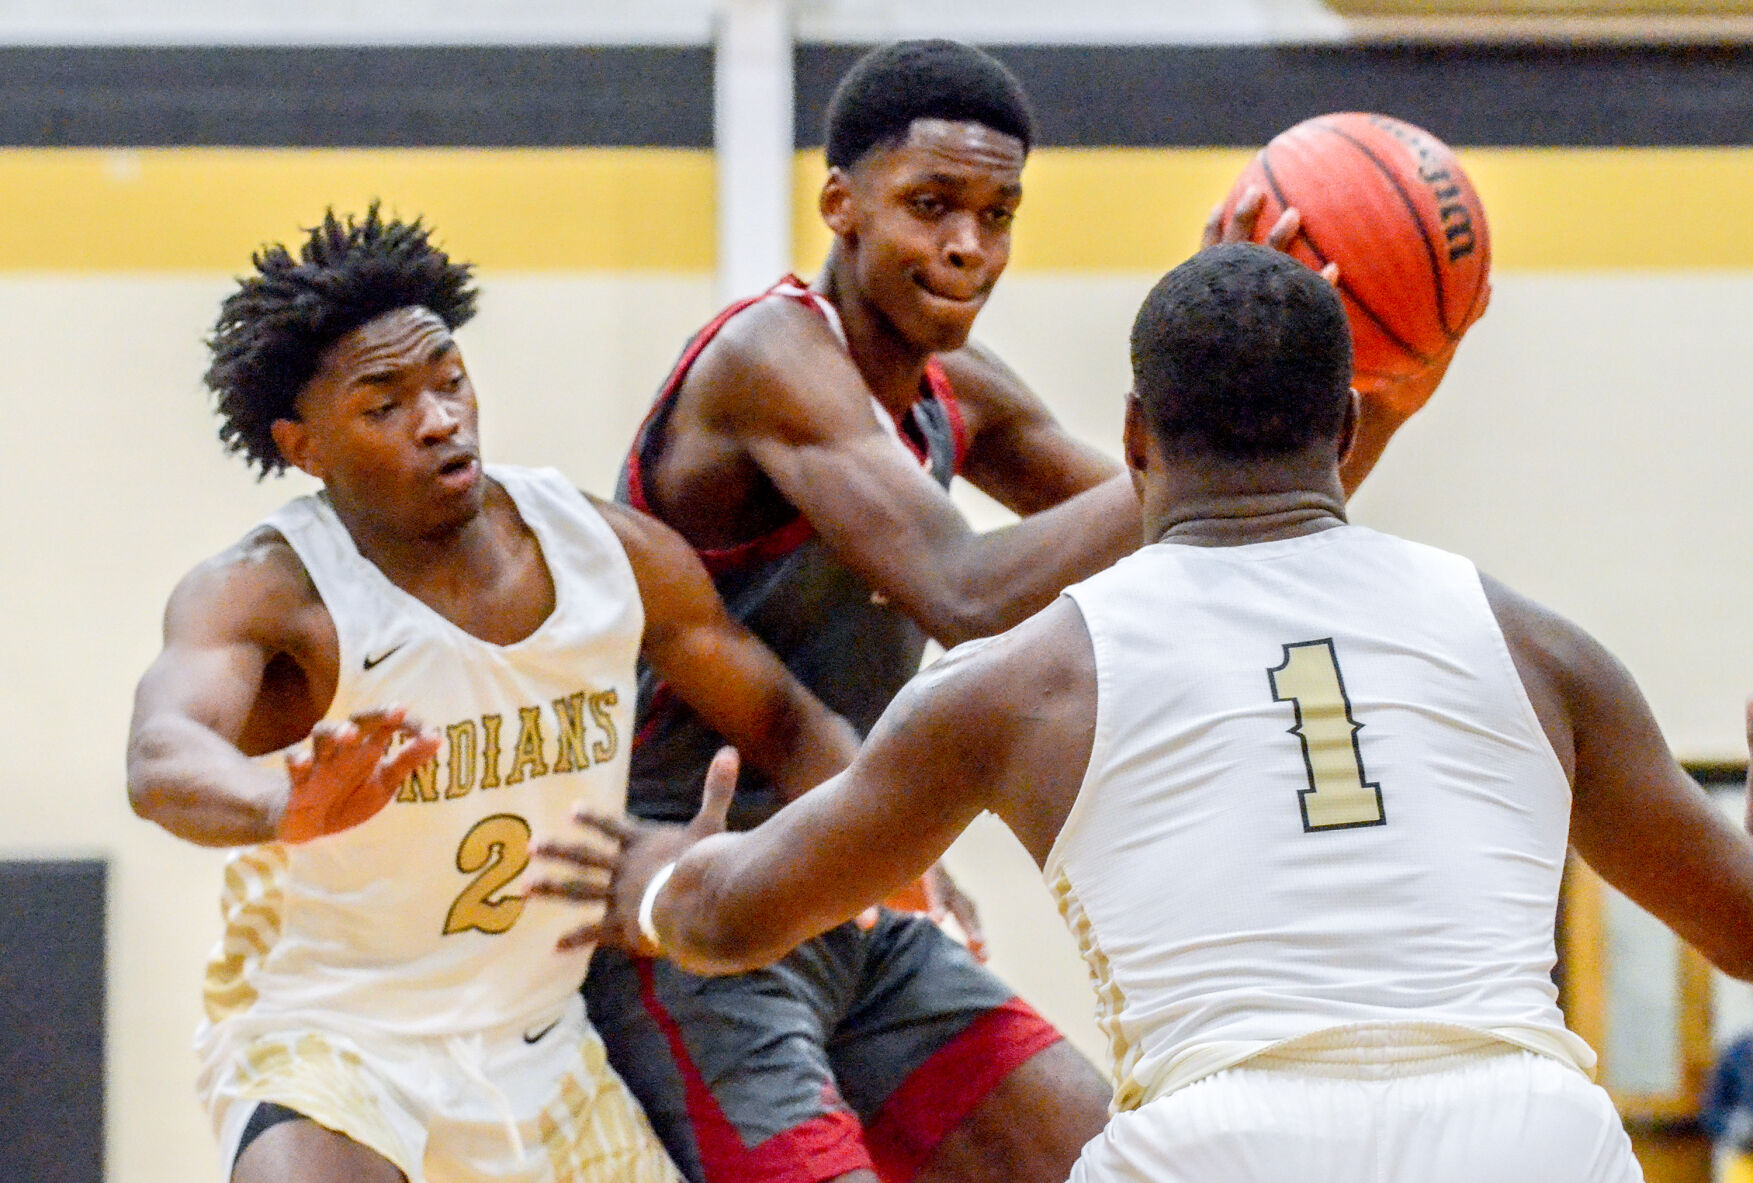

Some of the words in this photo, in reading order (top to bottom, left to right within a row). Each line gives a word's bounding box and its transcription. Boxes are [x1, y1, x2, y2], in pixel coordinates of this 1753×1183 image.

[386, 686, 619, 803] NDIANS
[1266, 637, 1387, 833] 1
[442, 812, 532, 937] 2
